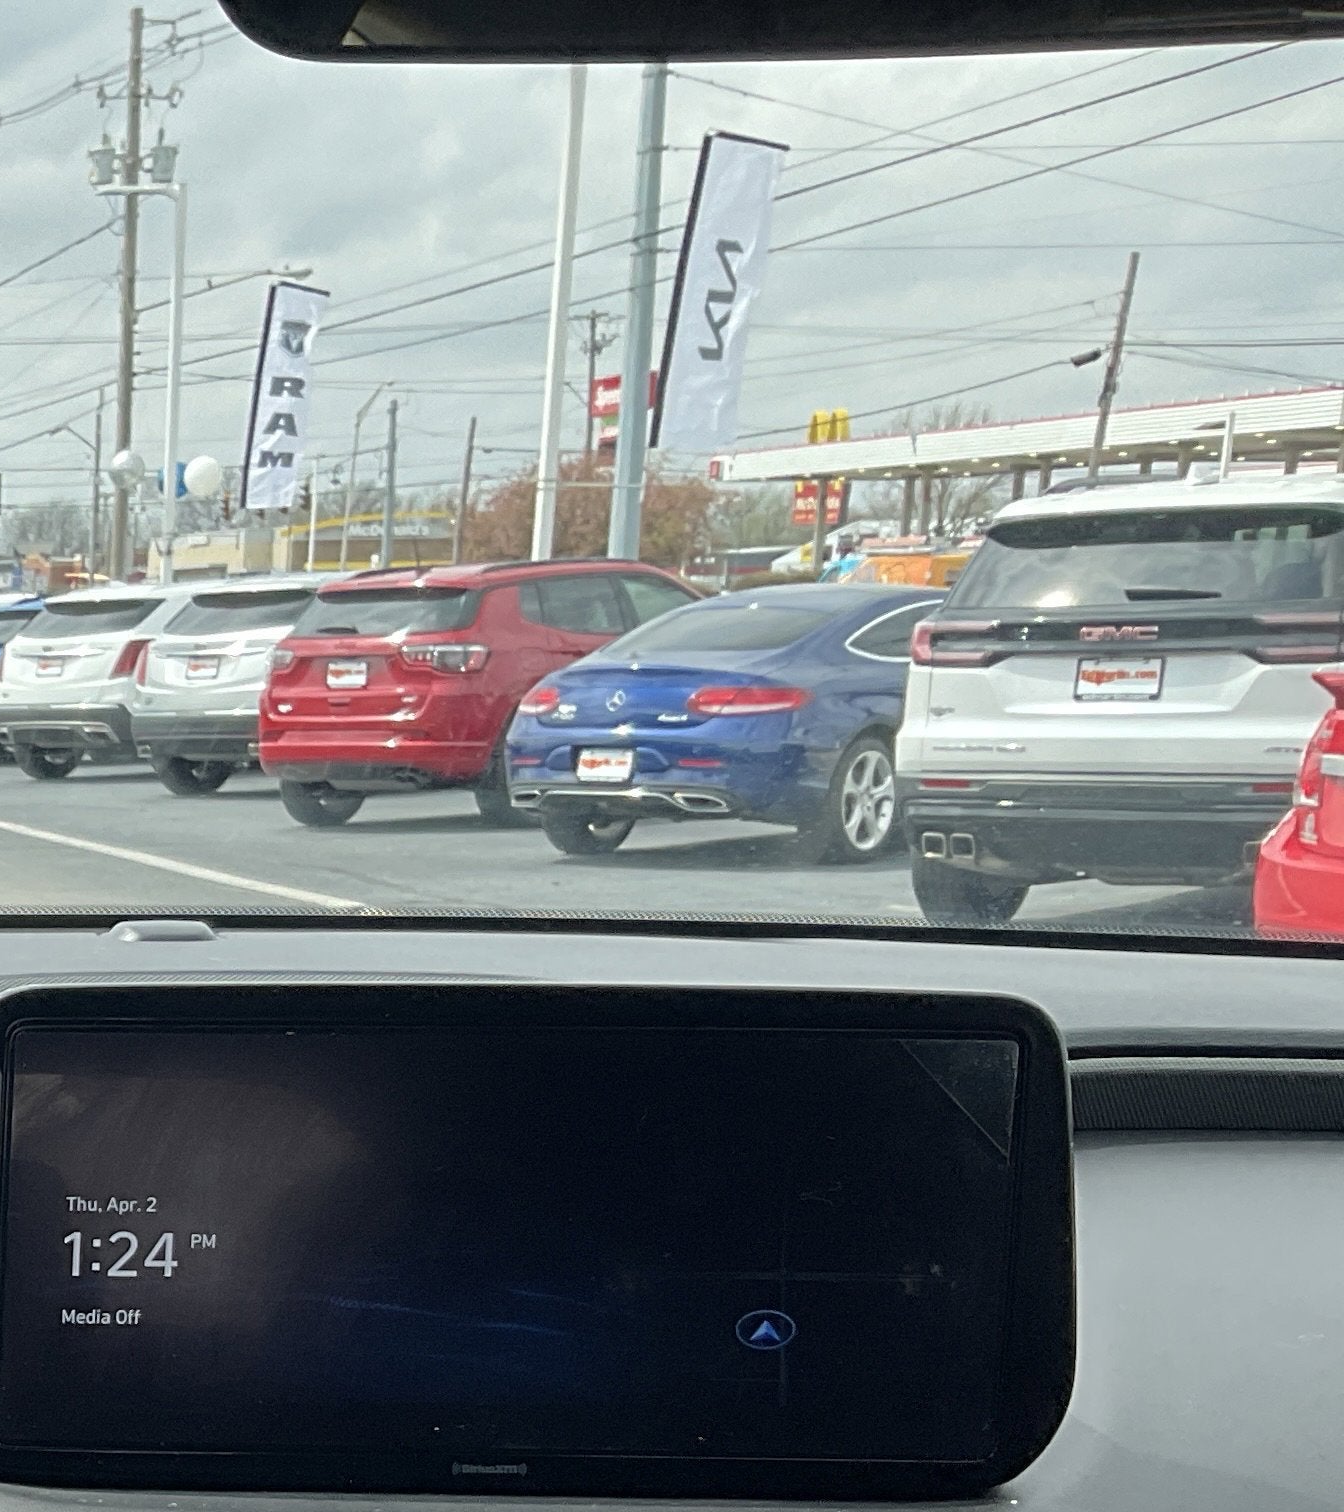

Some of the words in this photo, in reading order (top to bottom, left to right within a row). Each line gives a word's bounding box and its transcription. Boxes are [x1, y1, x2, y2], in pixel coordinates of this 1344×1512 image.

[257, 376, 306, 468] RAM
[1080, 625, 1159, 641] GMC
[65, 1196, 103, 1213] Thu,
[106, 1196, 142, 1215] Apr.
[145, 1196, 158, 1213] 2
[63, 1230, 179, 1278] 1:24
[190, 1233, 217, 1249] PM
[61, 1308, 111, 1325] Media
[115, 1308, 142, 1325] Off
